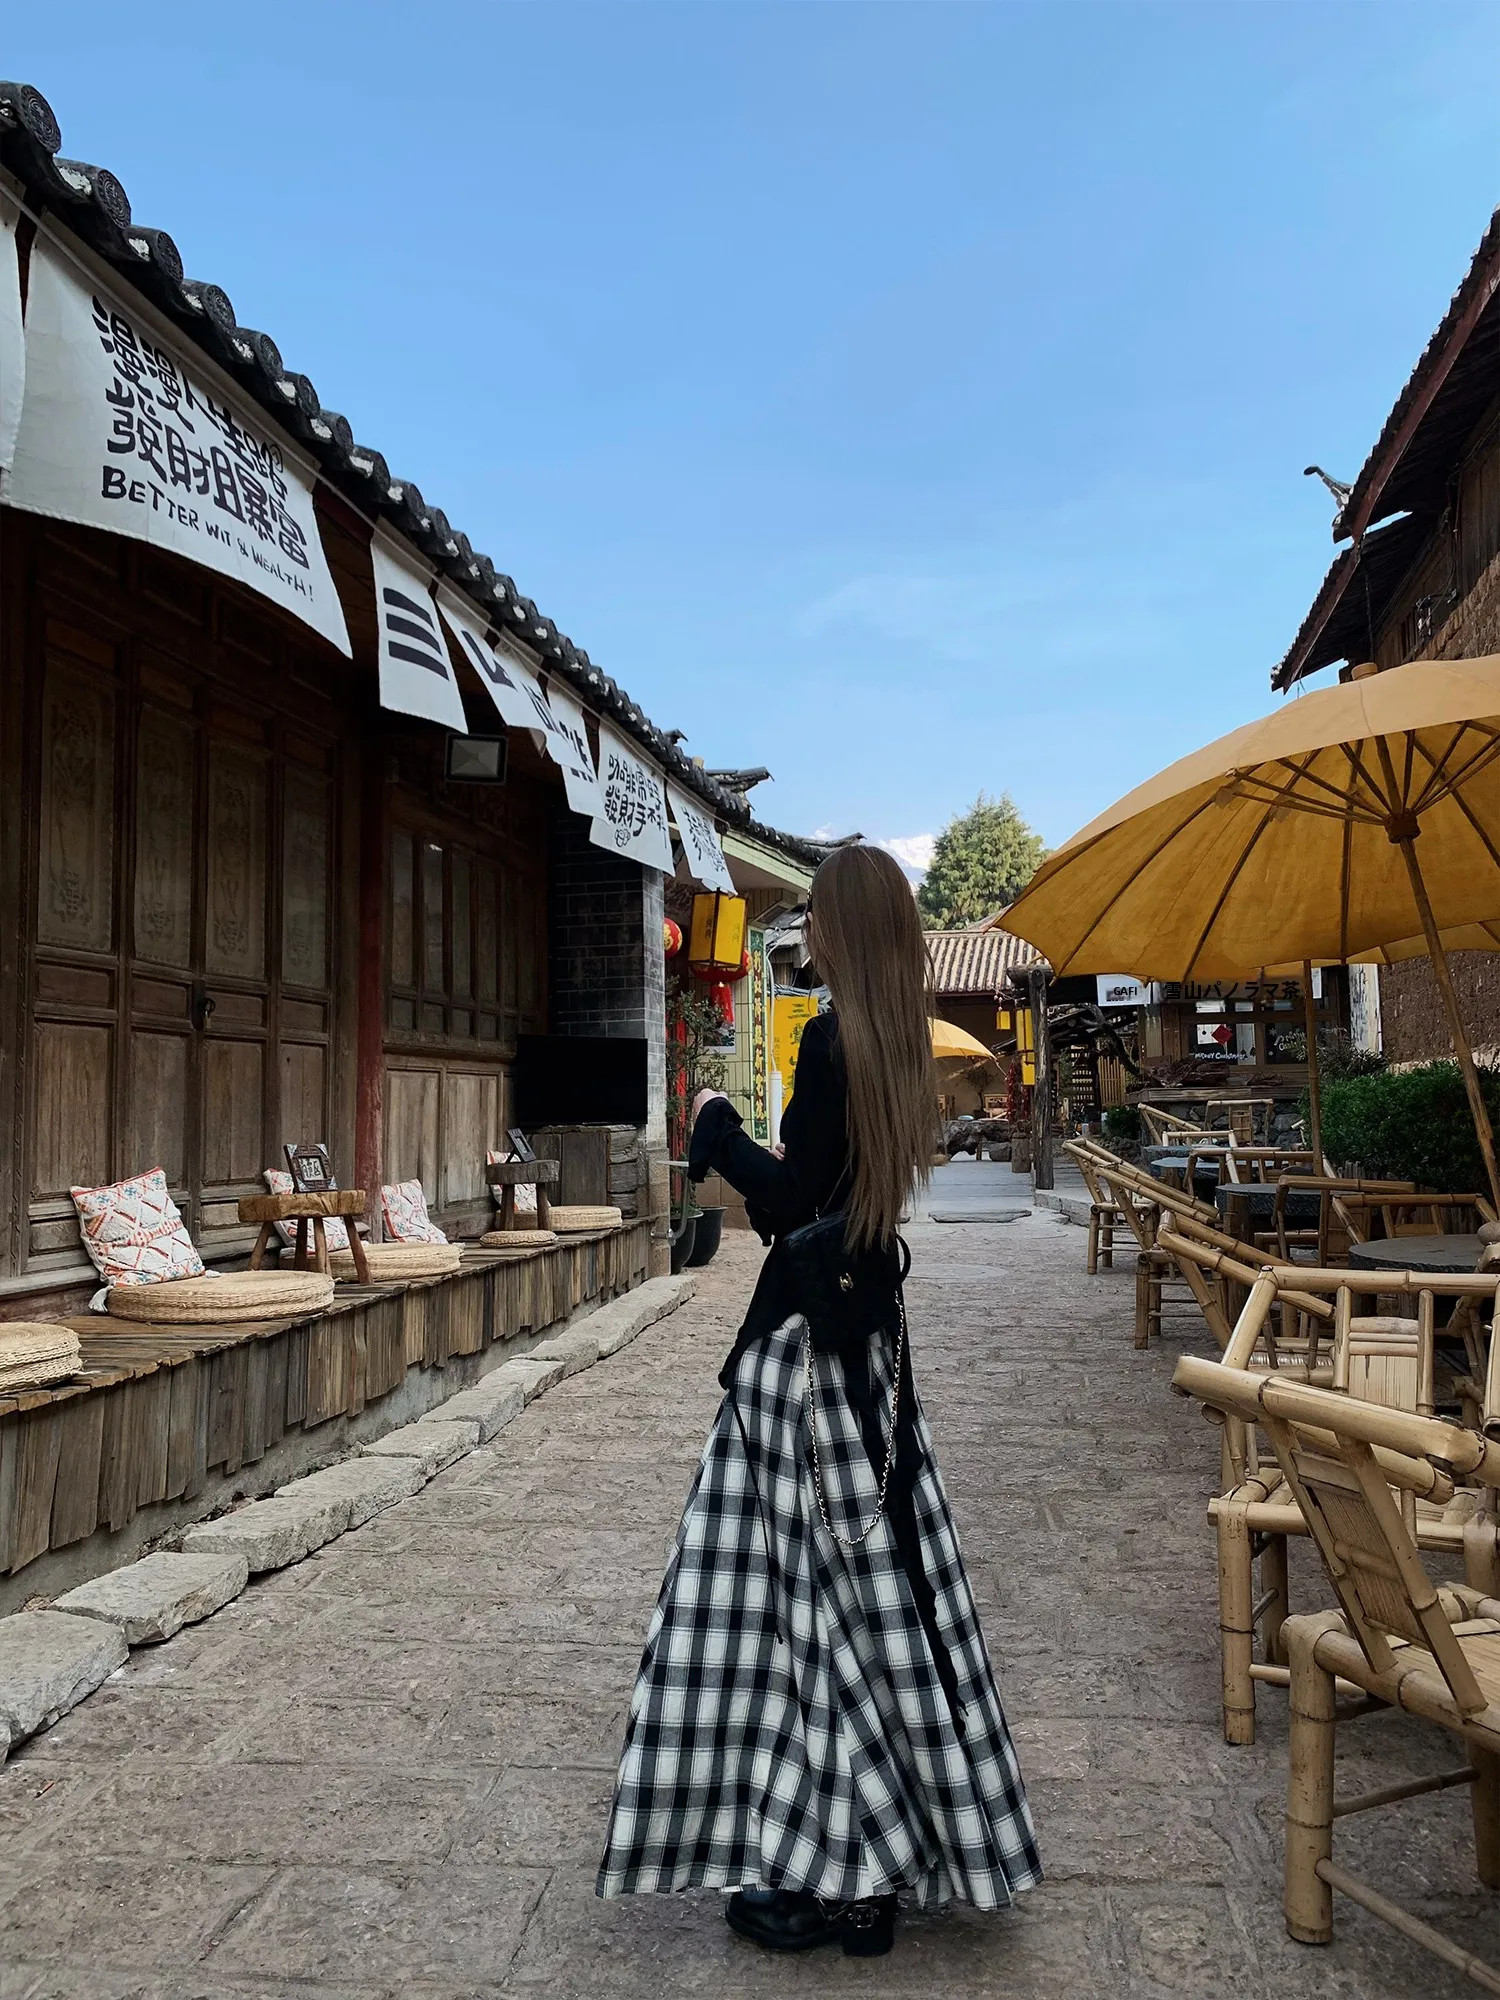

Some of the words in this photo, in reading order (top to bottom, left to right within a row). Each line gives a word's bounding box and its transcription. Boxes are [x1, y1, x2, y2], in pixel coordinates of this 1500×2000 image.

[92, 295, 287, 501] 漫漫人生路
[102, 466, 199, 532] BETTER
[205, 521, 231, 547] WIT
[237, 537, 249, 557] &
[251, 545, 314, 602] WEALTH!
[1113, 986, 1137, 996] GAFI
[1165, 981, 1300, 1000] 雪山パノラマ茶
